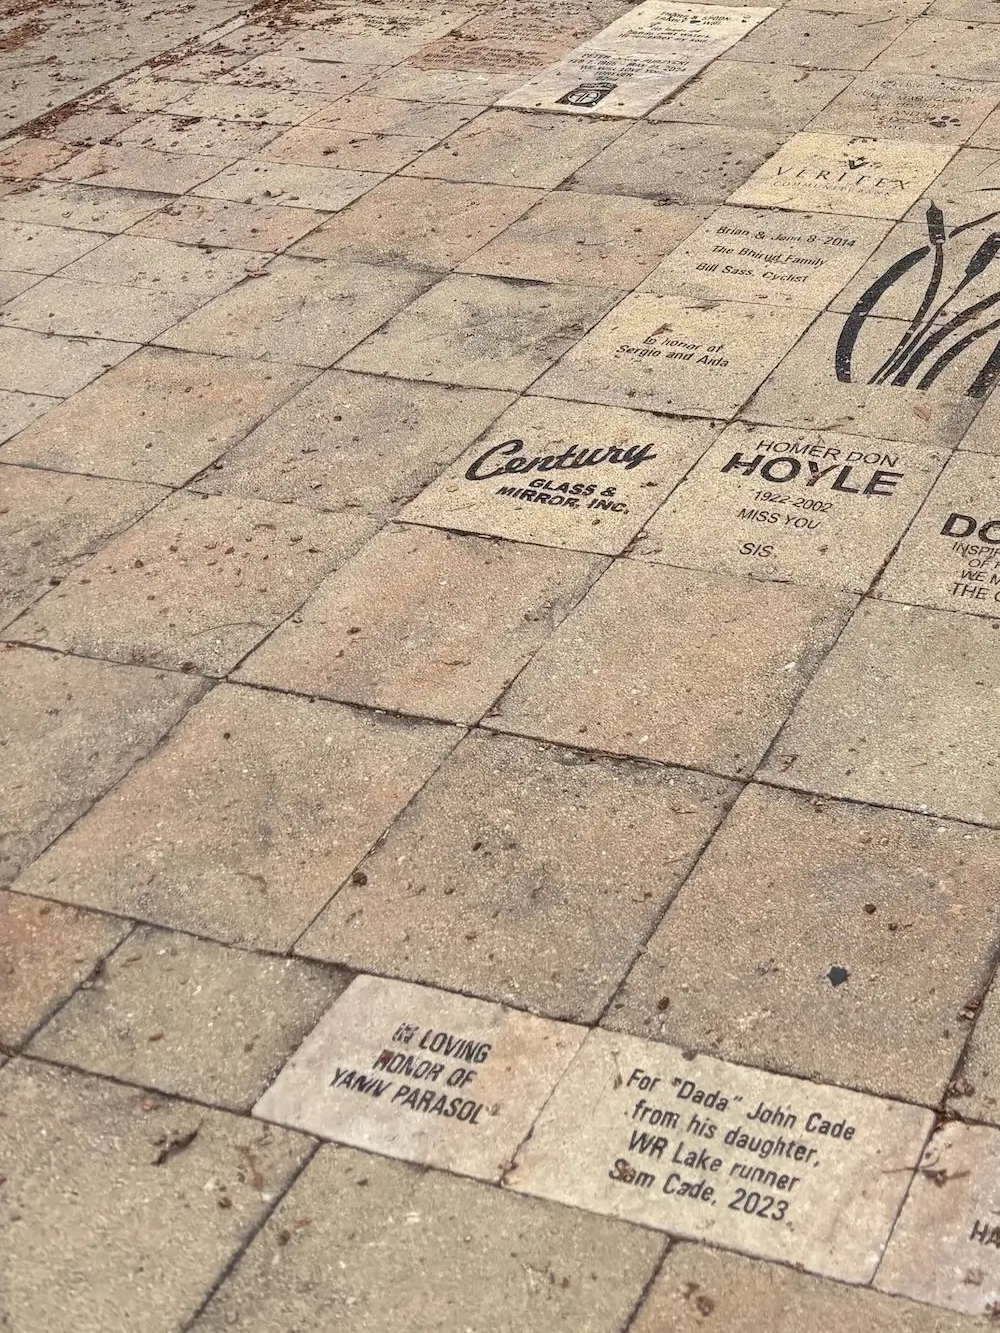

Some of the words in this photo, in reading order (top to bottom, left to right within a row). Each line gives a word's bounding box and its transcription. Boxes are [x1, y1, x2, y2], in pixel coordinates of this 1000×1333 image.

[775, 166, 913, 191] VERITEX
[715, 224, 751, 238] Brian
[753, 231, 767, 240] &
[711, 244, 735, 256] The
[784, 253, 829, 269] Family
[695, 262, 720, 273] Bill
[761, 270, 810, 285] Cyclist
[615, 343, 663, 358] Sergio
[665, 349, 694, 362] and
[698, 353, 730, 368] Aida
[642, 335, 660, 347] In
[662, 335, 700, 352] honor
[704, 341, 725, 354] of
[463, 438, 659, 482] Century
[755, 438, 843, 462] HOMER
[847, 450, 902, 467] DON
[720, 452, 905, 497] HOYLE
[528, 477, 600, 498] GLASS
[599, 484, 617, 498] &
[586, 497, 631, 515] INC.
[752, 489, 833, 514] 1922-2002
[736, 507, 781, 528] MISS
[782, 513, 823, 530] YOU
[959, 568, 988, 583] WE
[967, 556, 994, 570] OF
[951, 582, 988, 601] THE
[415, 1027, 494, 1066] LOVING
[444, 1064, 480, 1089] OF
[326, 1065, 390, 1100] YANIV
[389, 1082, 489, 1129] PARASOL
[625, 1066, 664, 1095] For
[671, 1077, 744, 1114] "Dada"
[746, 1098, 799, 1130] John
[802, 1109, 858, 1144] Cade
[629, 1098, 684, 1130] from
[684, 1113, 721, 1141] his
[723, 1122, 823, 1170] daughter,
[626, 1127, 671, 1159] WR
[670, 1139, 725, 1175] Lake
[727, 1159, 802, 1194] runner
[607, 1156, 658, 1191] Sam
[661, 1171, 720, 1207] Cade,
